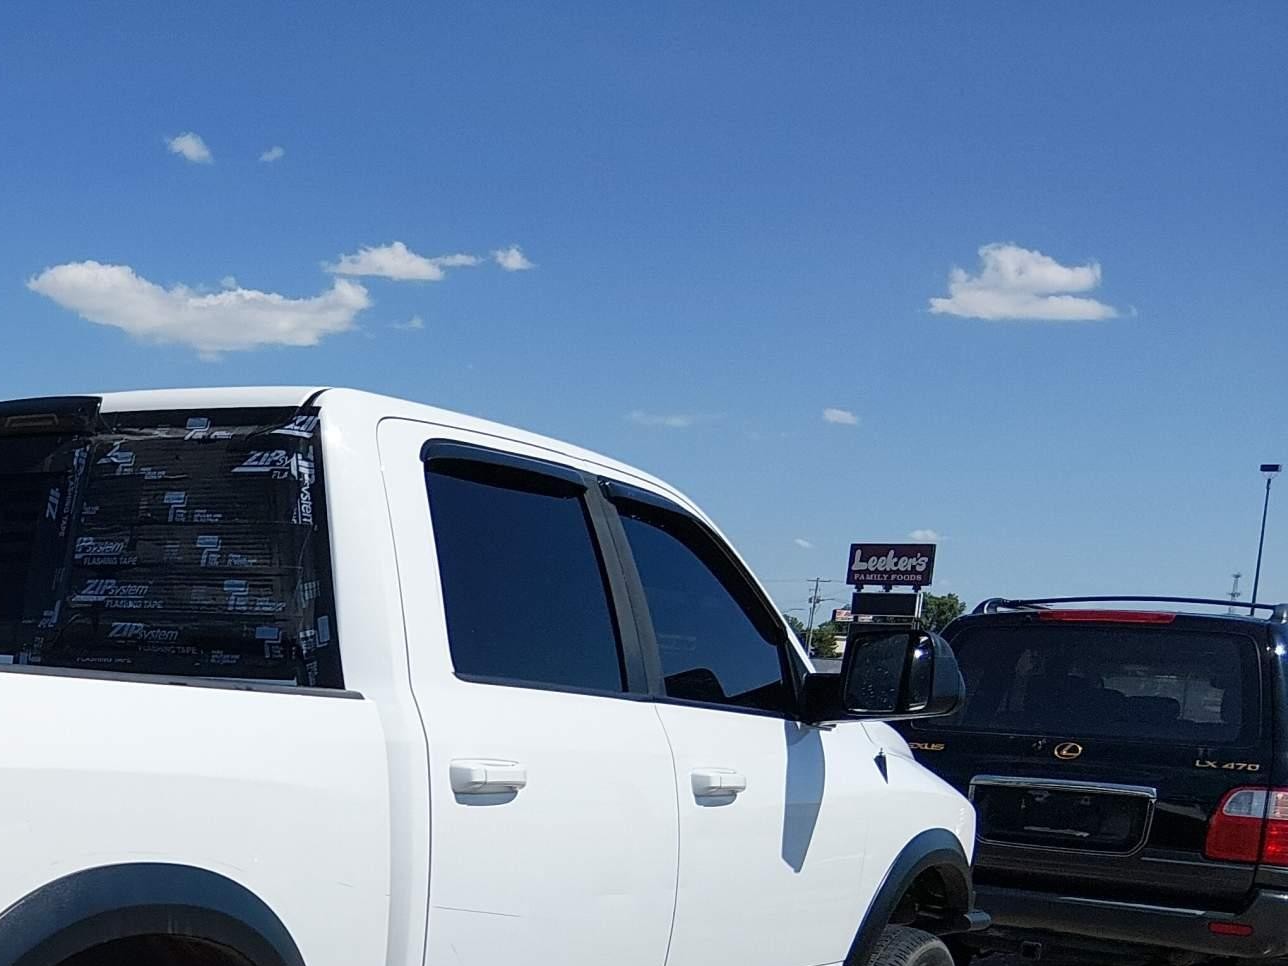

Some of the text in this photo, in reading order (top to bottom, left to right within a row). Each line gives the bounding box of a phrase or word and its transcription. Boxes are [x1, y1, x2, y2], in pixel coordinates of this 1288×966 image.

[852, 549, 928, 571] Leeker's
[909, 742, 945, 751] EXUS
[1195, 760, 1260, 772] LX 470
